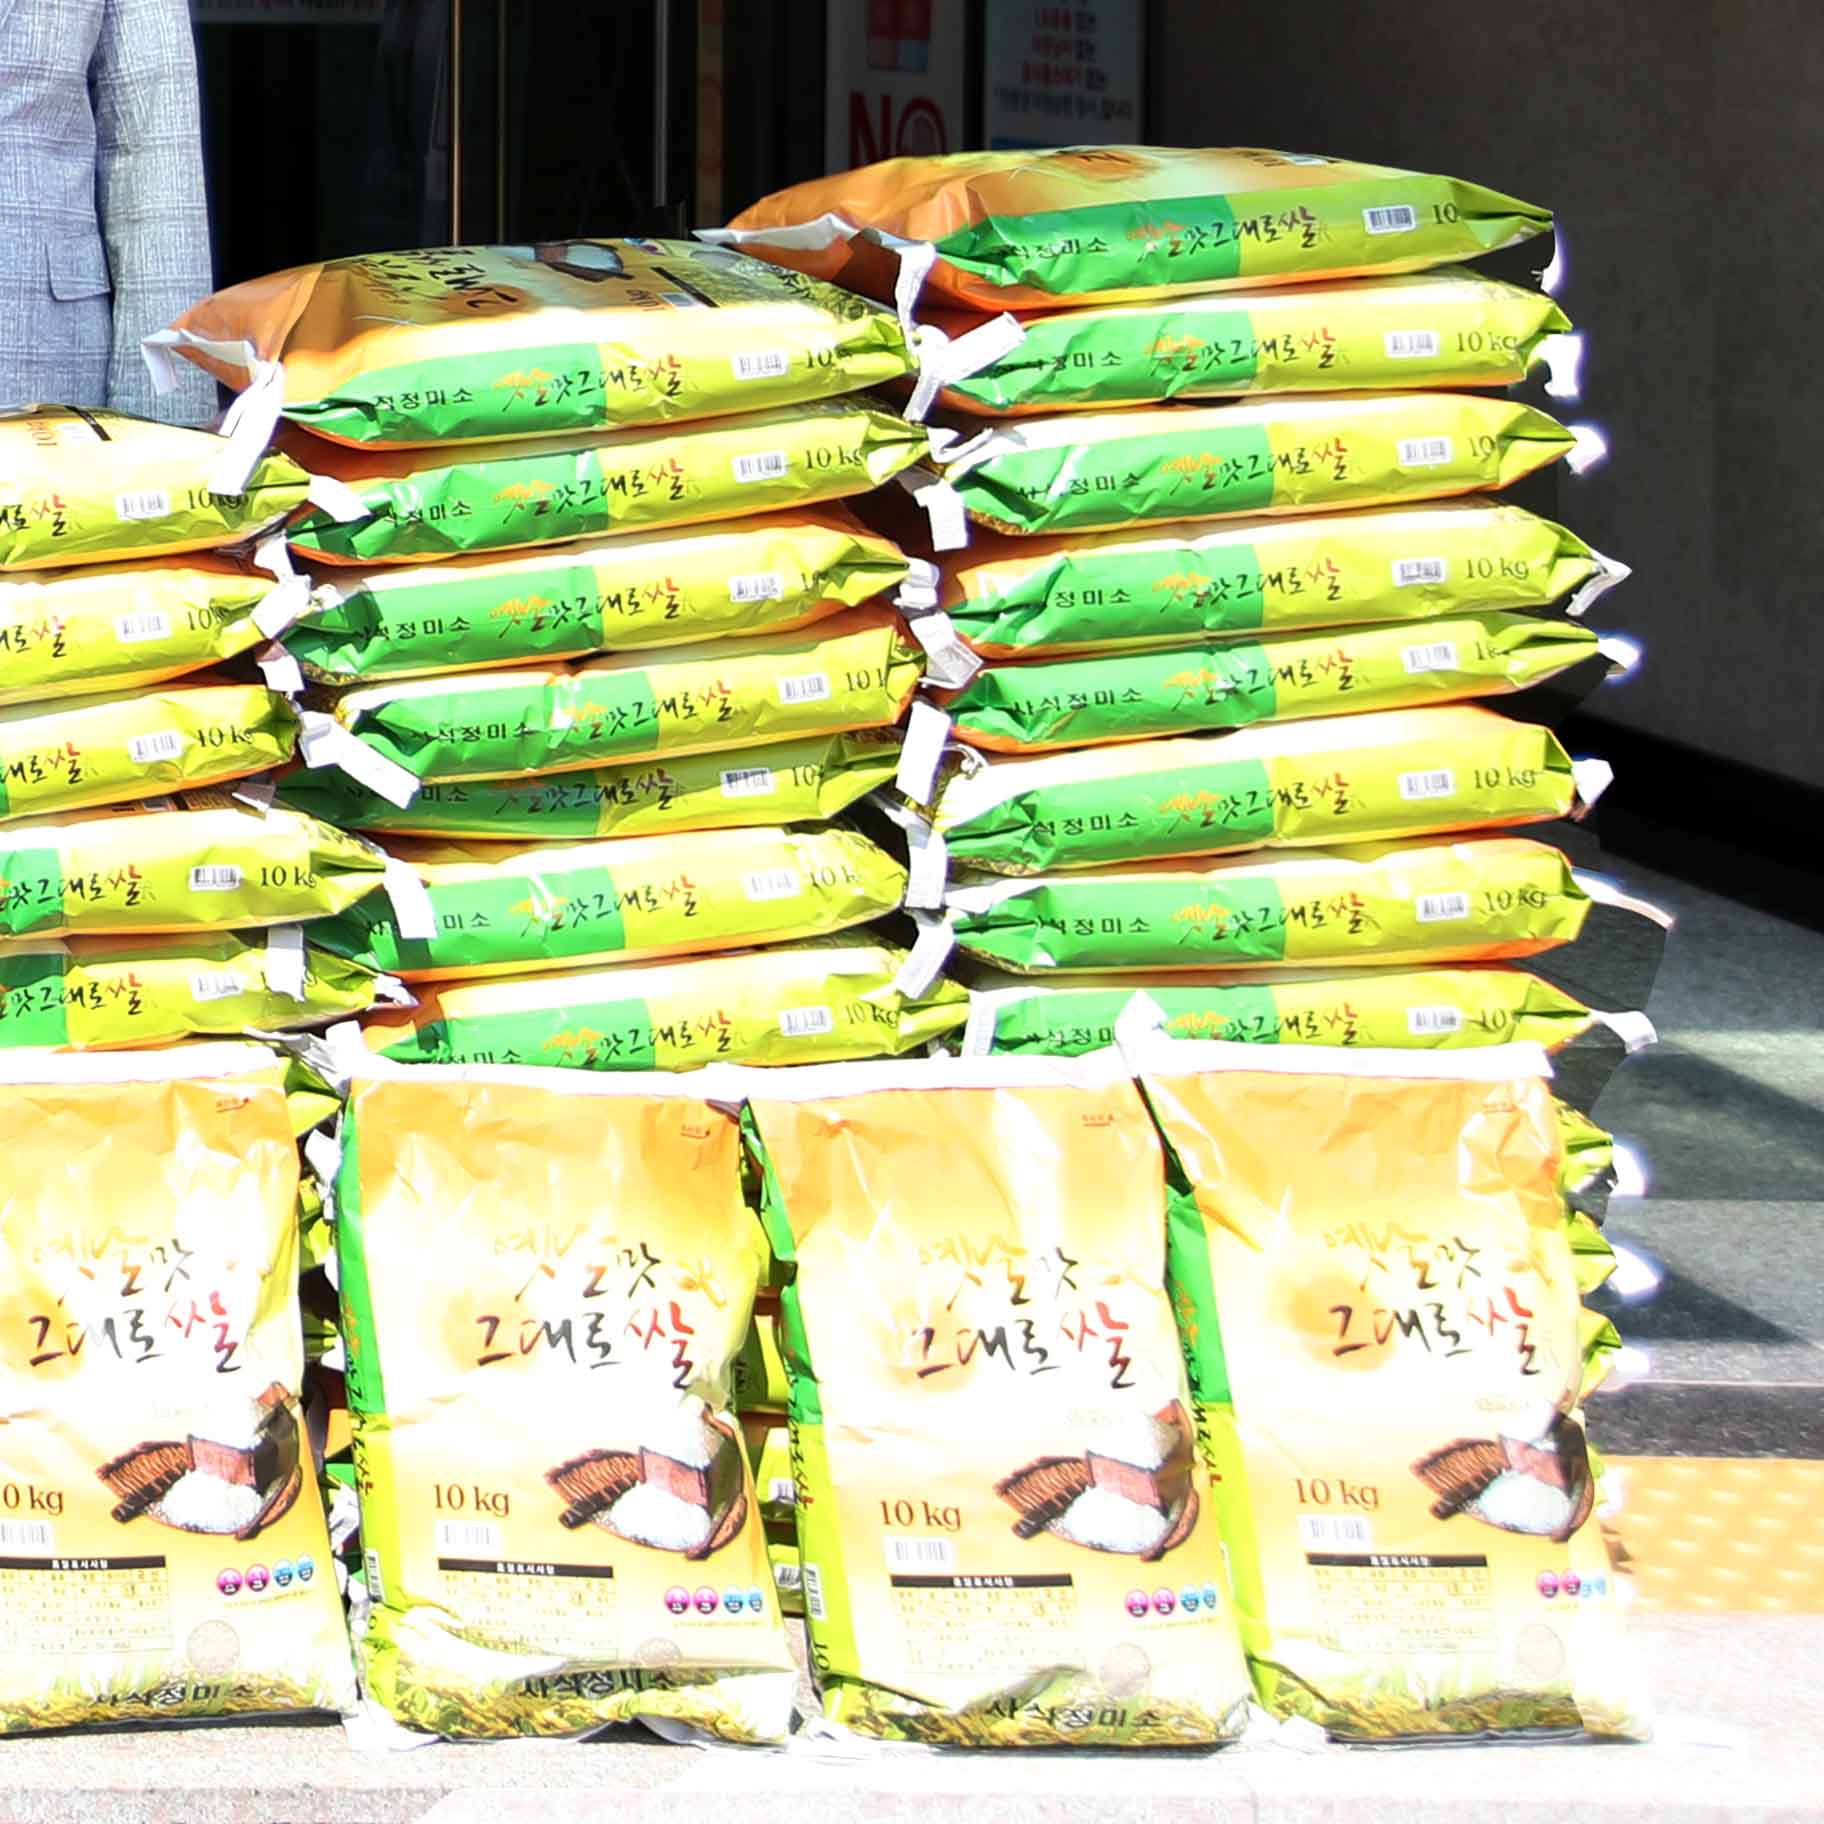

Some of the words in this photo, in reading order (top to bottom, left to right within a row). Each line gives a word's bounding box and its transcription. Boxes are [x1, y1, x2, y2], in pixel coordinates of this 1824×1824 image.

[805, 449, 831, 470] 10
[1467, 559, 1490, 580] 10
[1495, 559, 1529, 583] kg
[1473, 766, 1499, 788] 10
[28, 1482, 64, 1514] kg
[434, 1484, 464, 1510] 10
[473, 1484, 511, 1518] kg
[1294, 1478, 1329, 1505] 10
[1341, 1480, 1379, 1510] kg
[880, 1500, 911, 1526] 10
[923, 1501, 961, 1533] kg
